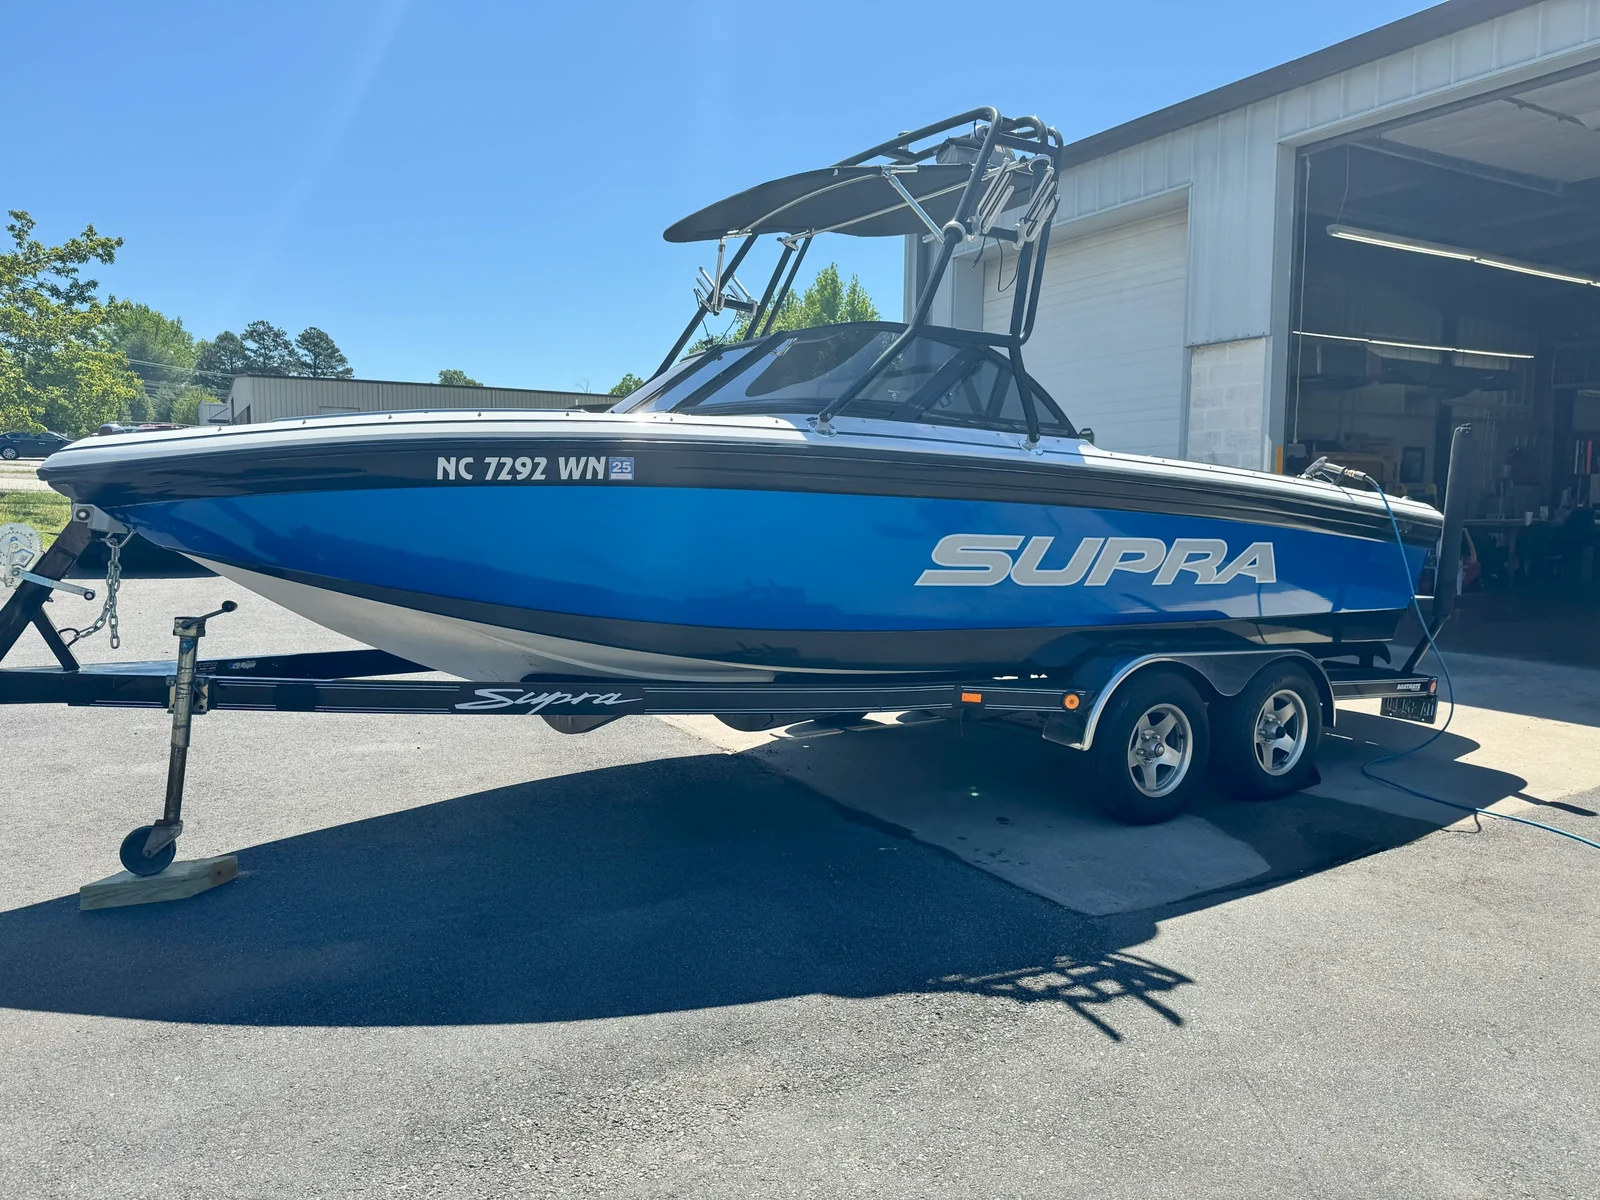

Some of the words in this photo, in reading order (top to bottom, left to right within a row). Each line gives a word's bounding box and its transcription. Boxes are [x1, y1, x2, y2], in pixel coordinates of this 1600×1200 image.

[436, 456, 474, 481] NC
[484, 456, 548, 481] 7292
[558, 456, 606, 480] WN
[612, 461, 632, 473] 25
[914, 533, 1277, 586] SUPRA
[454, 688, 643, 715] Supra
